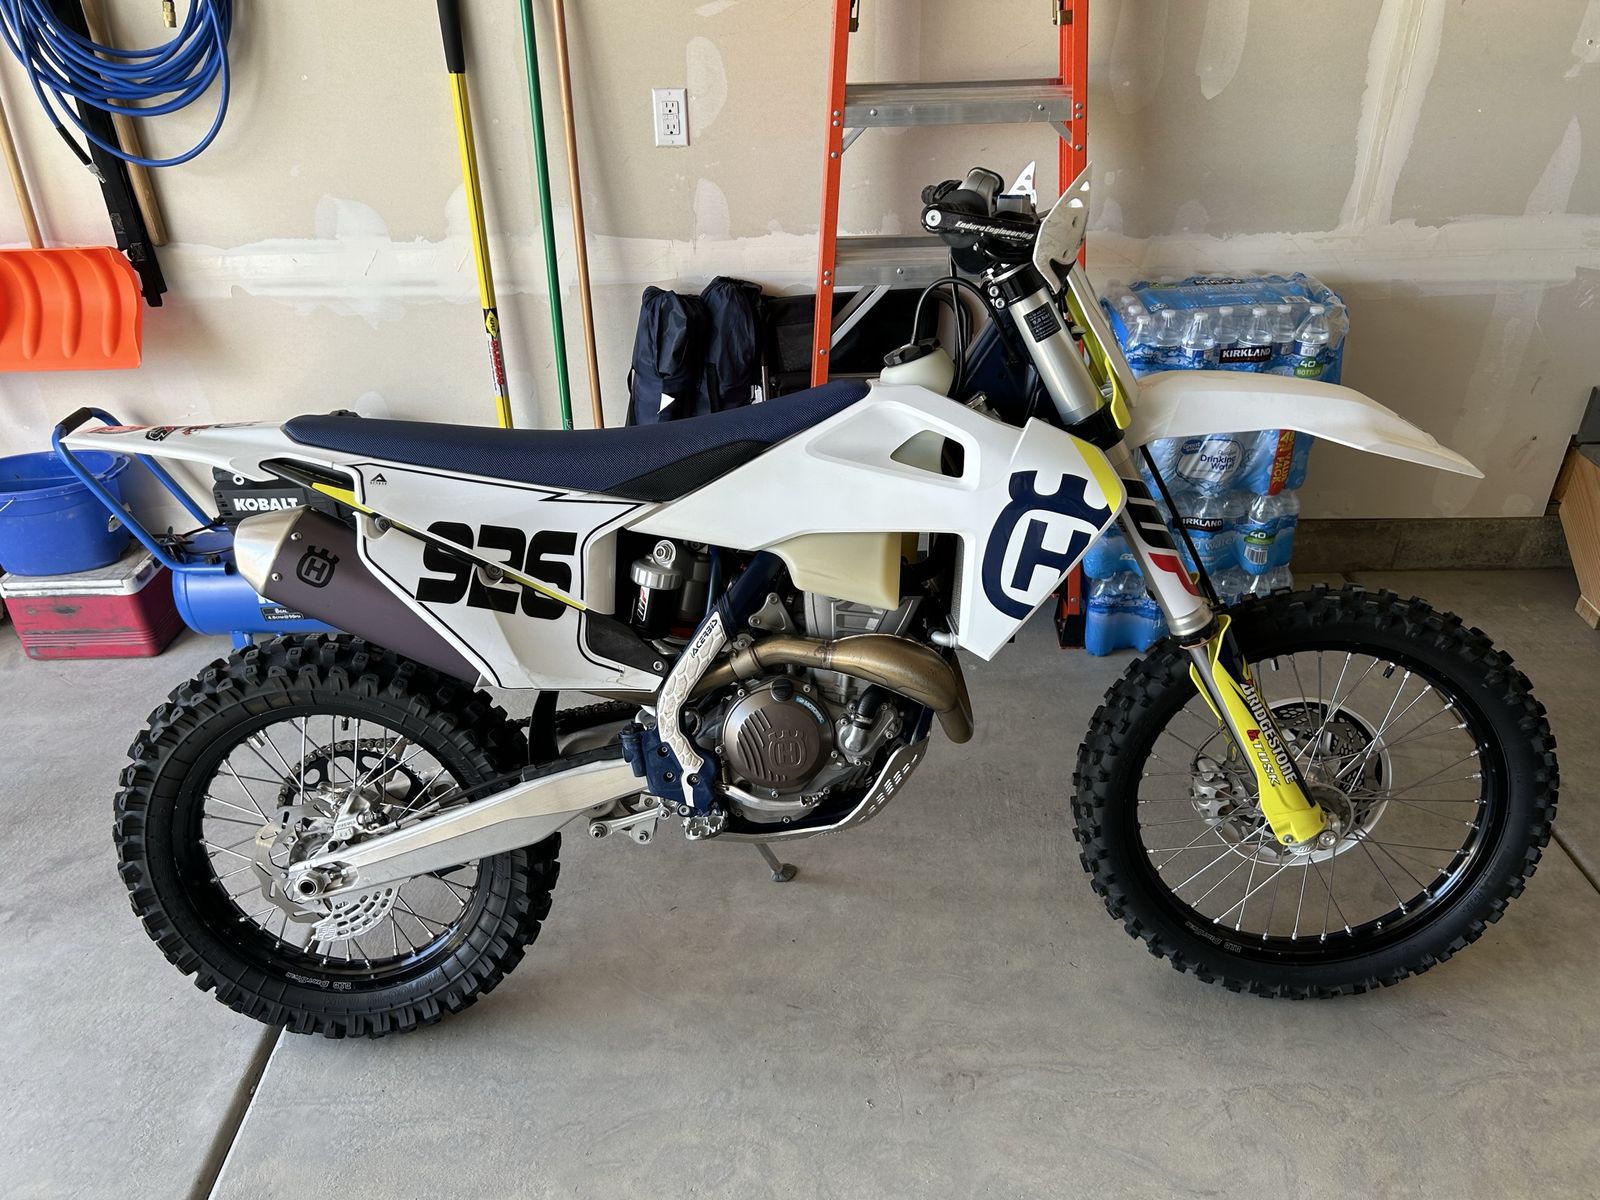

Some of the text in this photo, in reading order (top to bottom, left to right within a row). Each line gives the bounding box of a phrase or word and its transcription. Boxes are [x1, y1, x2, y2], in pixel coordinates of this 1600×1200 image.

[955, 221, 985, 231] Enduro
[985, 226, 1034, 239] Engineering
[1222, 347, 1271, 358] KIRKLAND
[233, 497, 299, 511] KOBALT
[1182, 518, 1222, 527] IRKLAND
[1250, 531, 1266, 539] 40
[692, 619, 718, 657] ACERBIS
[1240, 682, 1298, 785] BRIDGESTONE
[1253, 740, 1281, 787] TUSK
